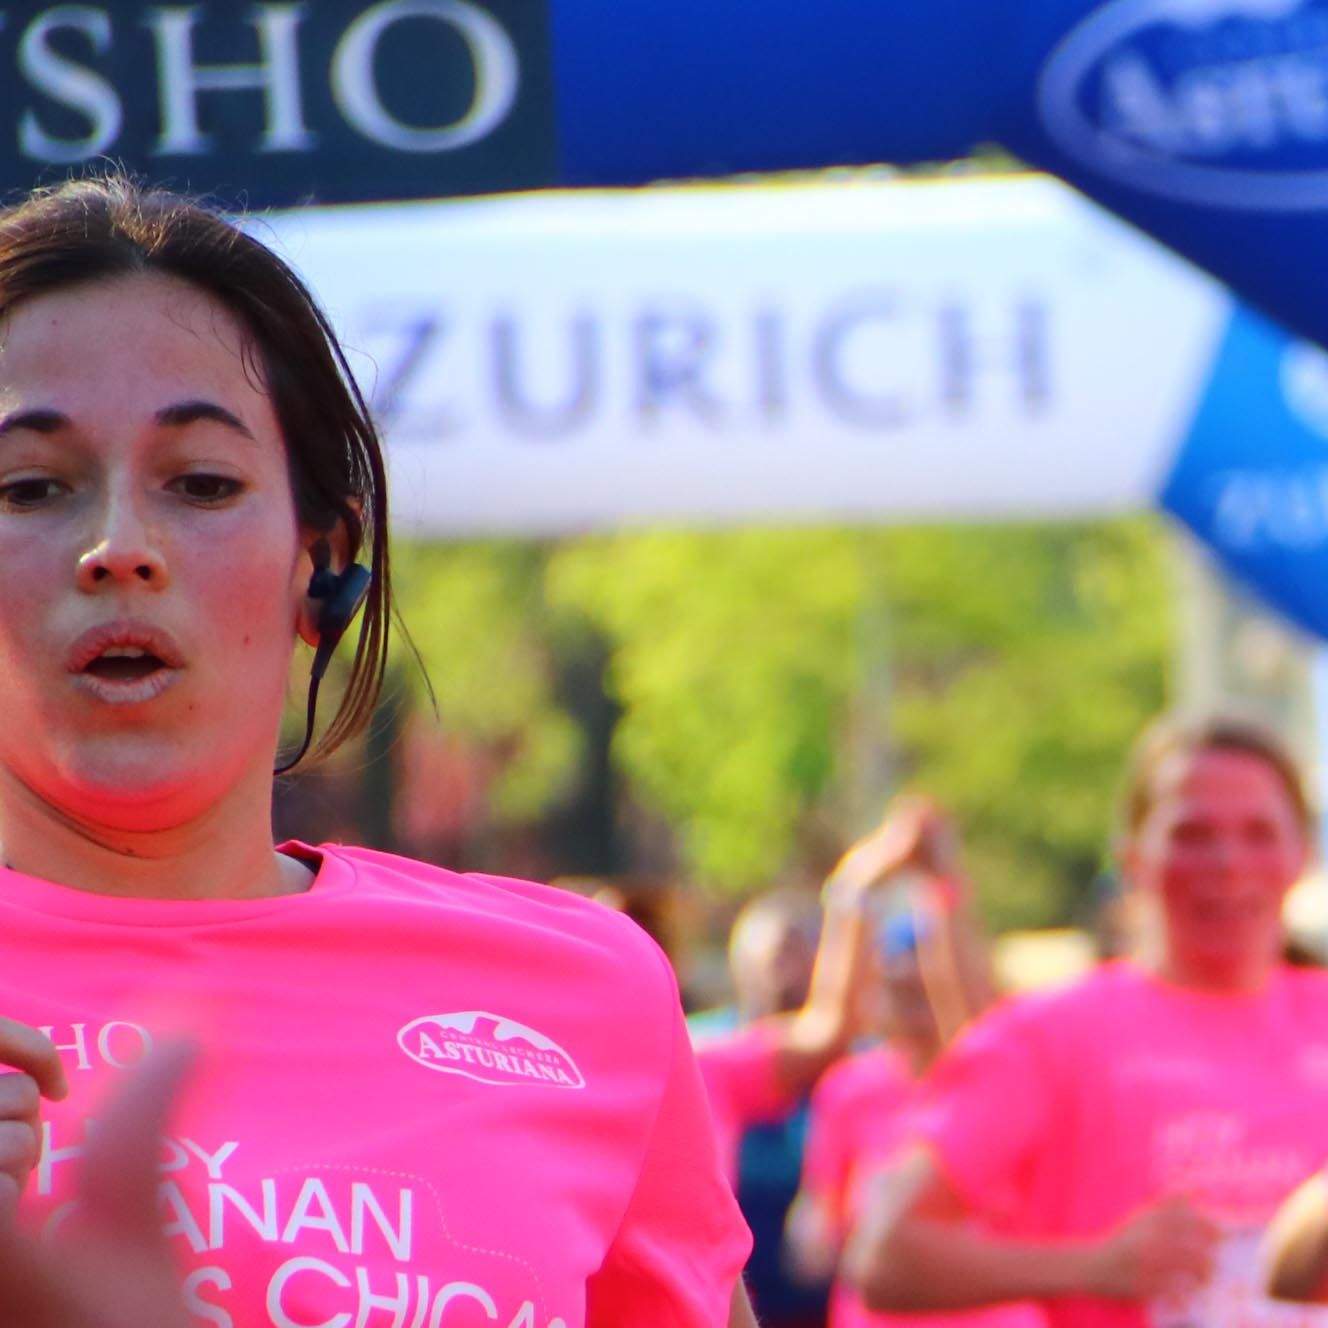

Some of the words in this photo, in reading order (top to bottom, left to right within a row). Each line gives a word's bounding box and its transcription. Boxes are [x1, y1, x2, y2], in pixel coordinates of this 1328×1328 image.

[0, 1, 521, 163] SHO
[364, 290, 1055, 442] ZURICH
[418, 1031, 574, 1086] ASTURIANA
